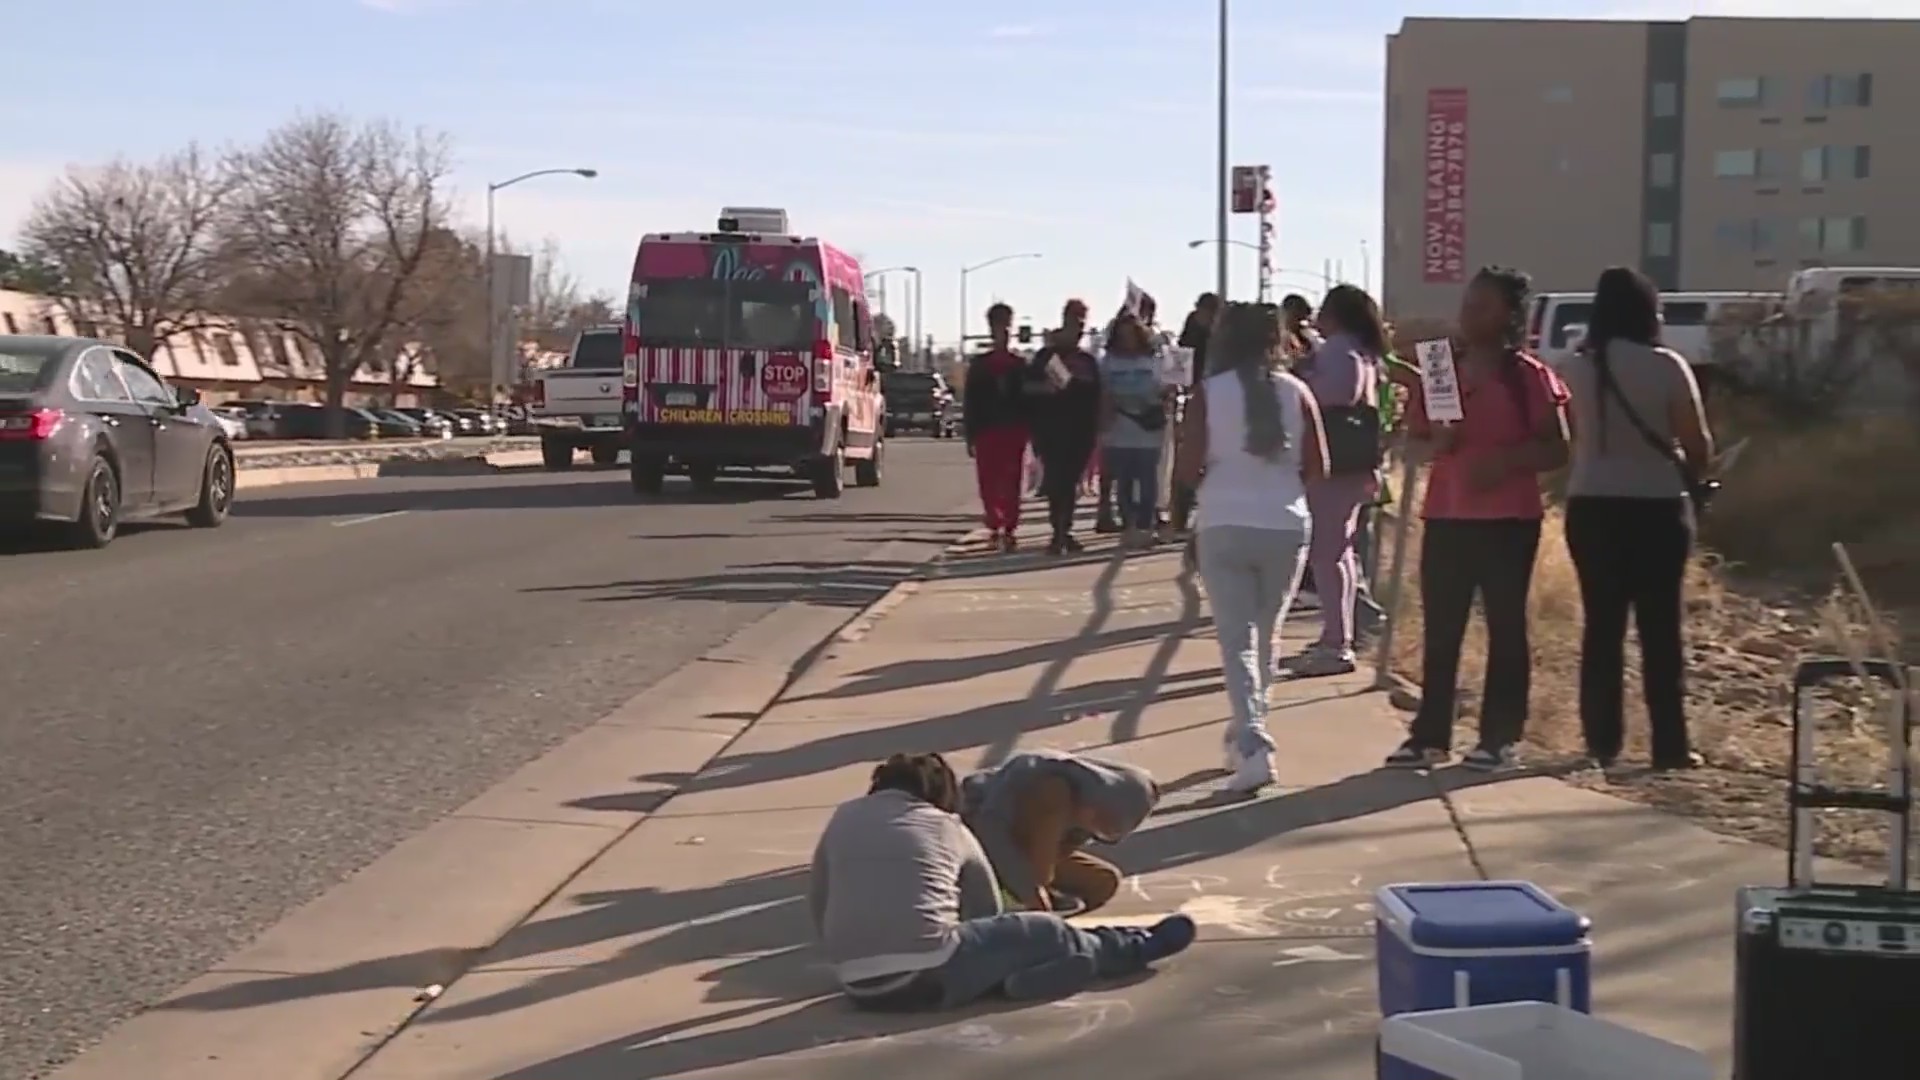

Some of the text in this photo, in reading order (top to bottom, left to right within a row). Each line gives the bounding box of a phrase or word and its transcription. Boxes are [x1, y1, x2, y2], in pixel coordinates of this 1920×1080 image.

[1426, 113, 1447, 273] NOW LEASING!
[764, 365, 804, 382] STOP
[660, 408, 790, 425] CHILDREN CROSSING
